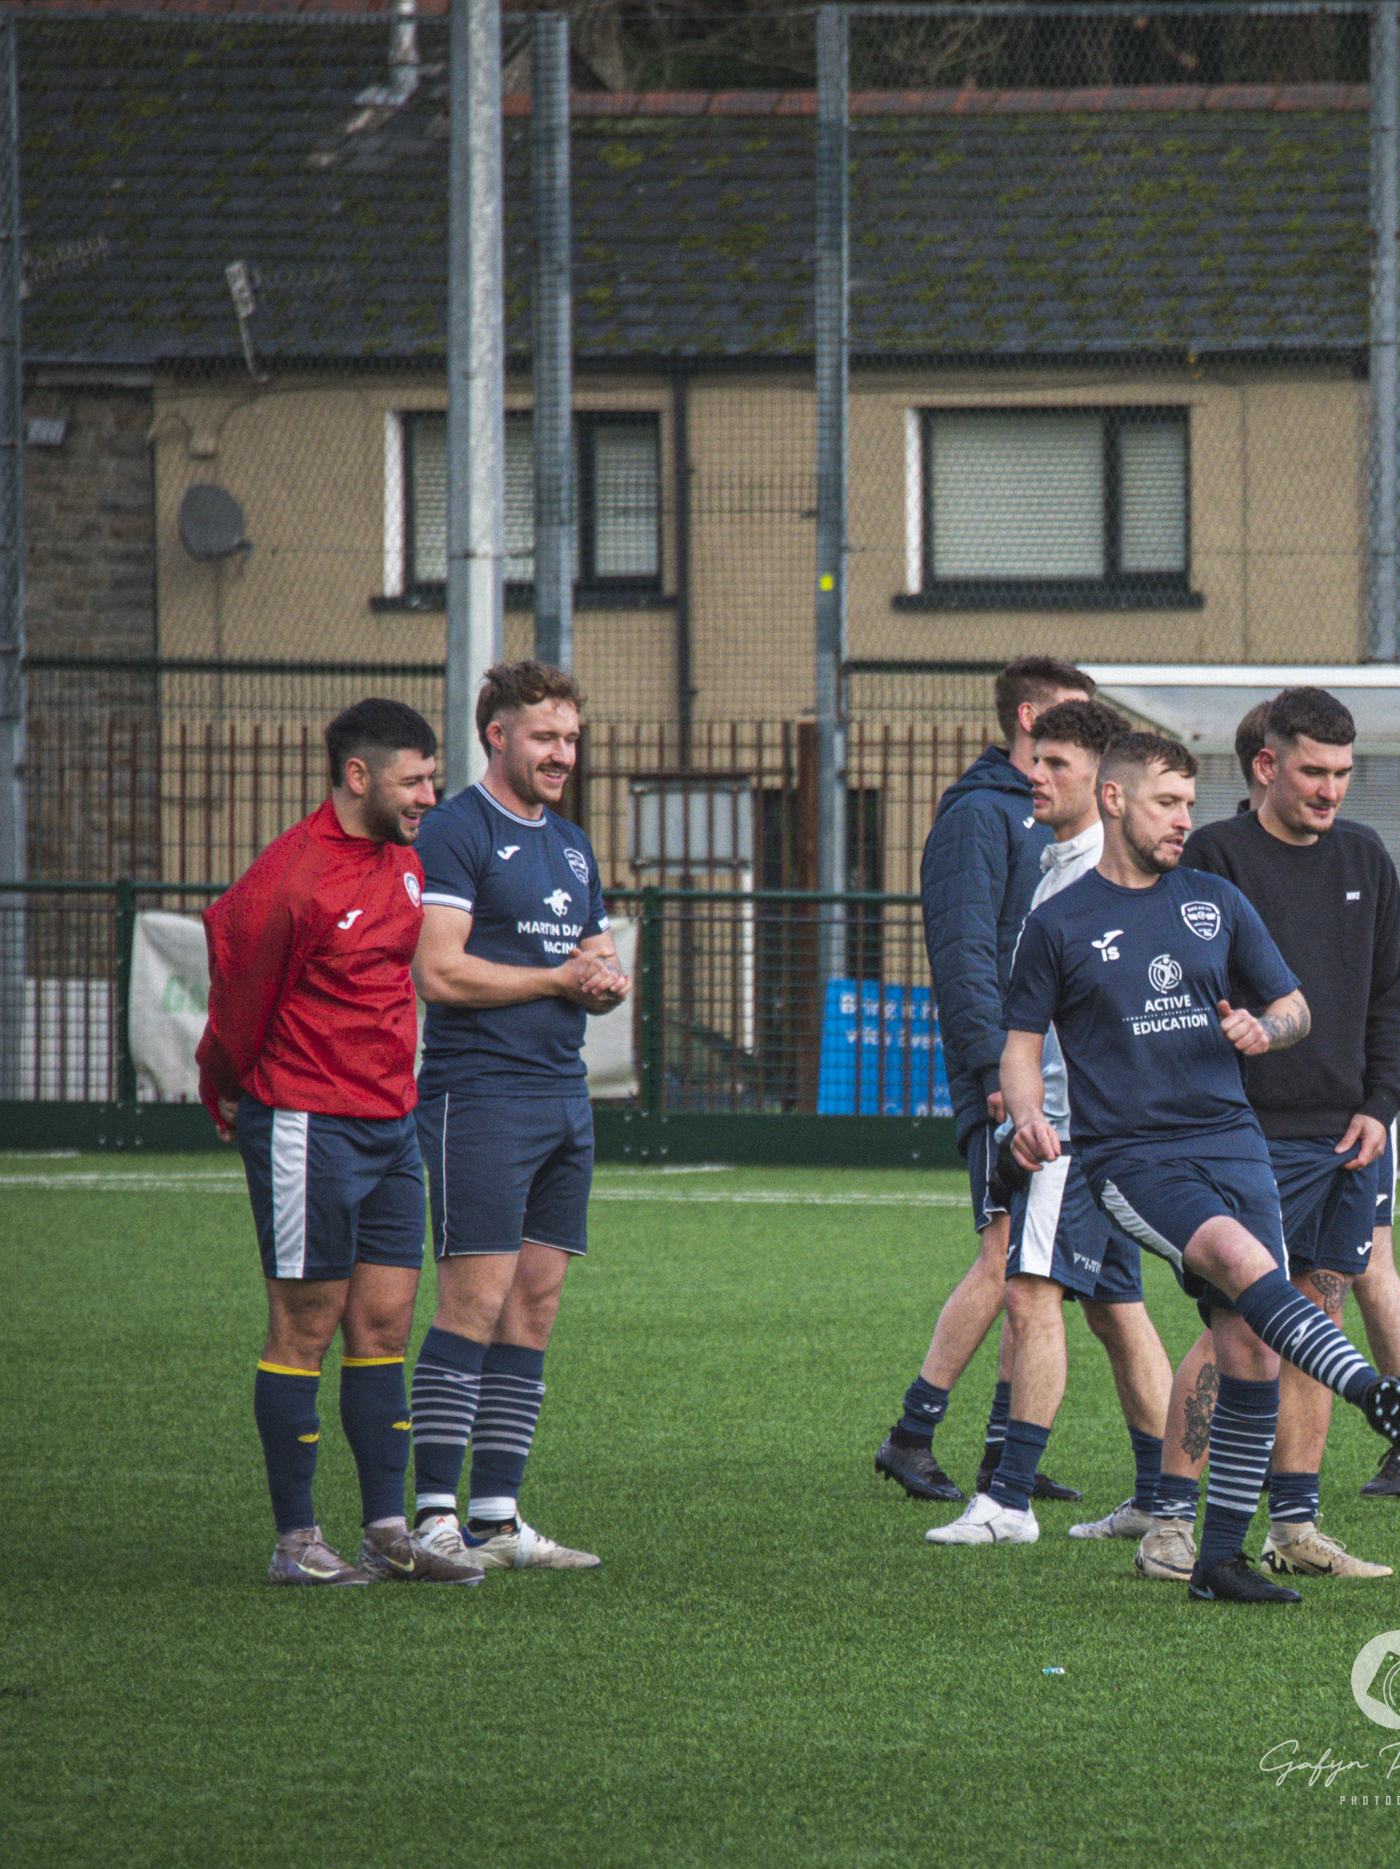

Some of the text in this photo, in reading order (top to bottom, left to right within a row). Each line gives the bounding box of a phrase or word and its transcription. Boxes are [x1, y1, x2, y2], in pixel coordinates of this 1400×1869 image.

[1346, 891, 1360, 900] NIKE
[517, 921, 560, 936] MARTIN
[543, 940, 577, 954] RACIN
[1145, 994, 1191, 1013] ACTIVE
[1132, 1013, 1208, 1036] EDUCATION
